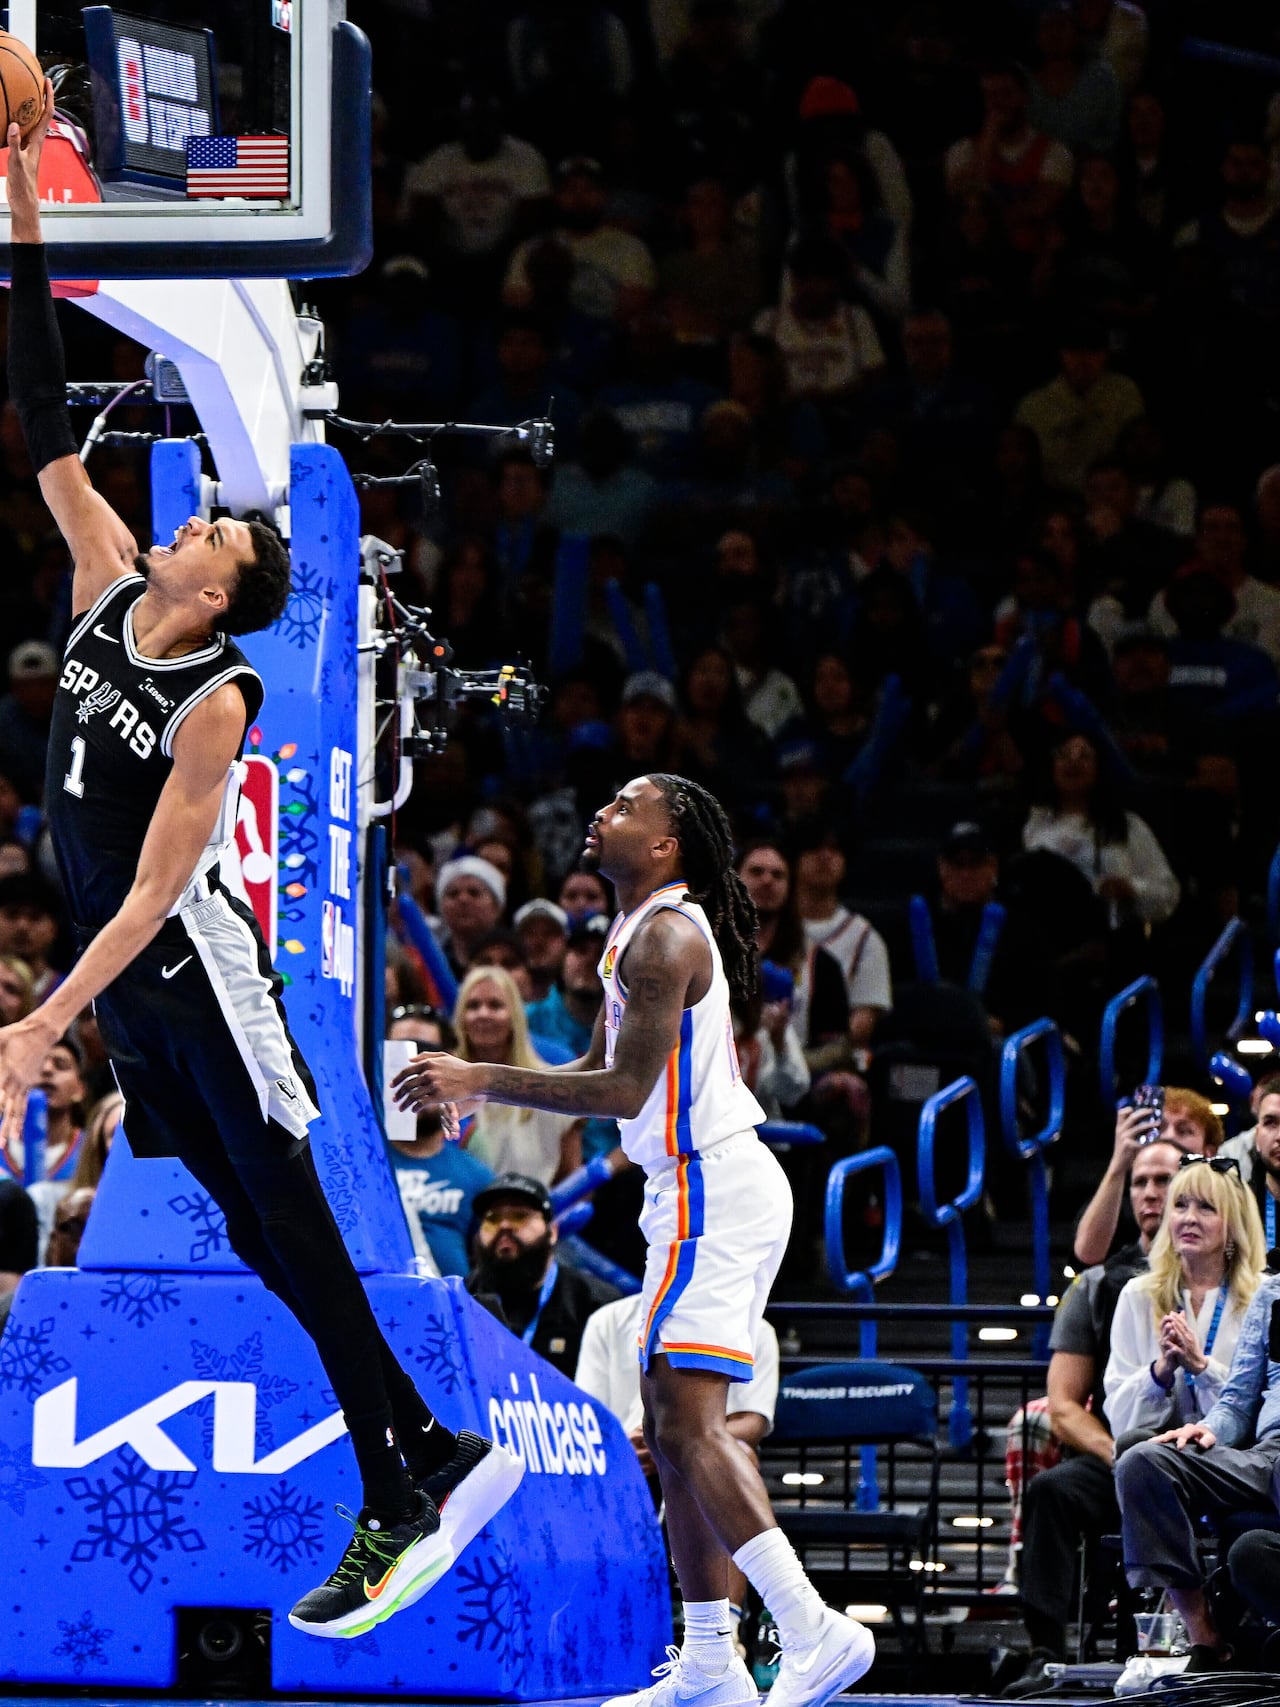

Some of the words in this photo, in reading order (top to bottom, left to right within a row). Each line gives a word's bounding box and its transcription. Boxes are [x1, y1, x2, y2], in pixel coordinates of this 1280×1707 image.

[59, 659, 157, 760] SPURS
[141, 680, 171, 710] LEDGER
[63, 735, 86, 799] 1
[330, 746, 352, 821] GET
[328, 823, 352, 900] THE
[488, 1371, 606, 1476] coinbase
[782, 1387, 847, 1400] THUNDER
[847, 1383, 915, 1399] SECURITY
